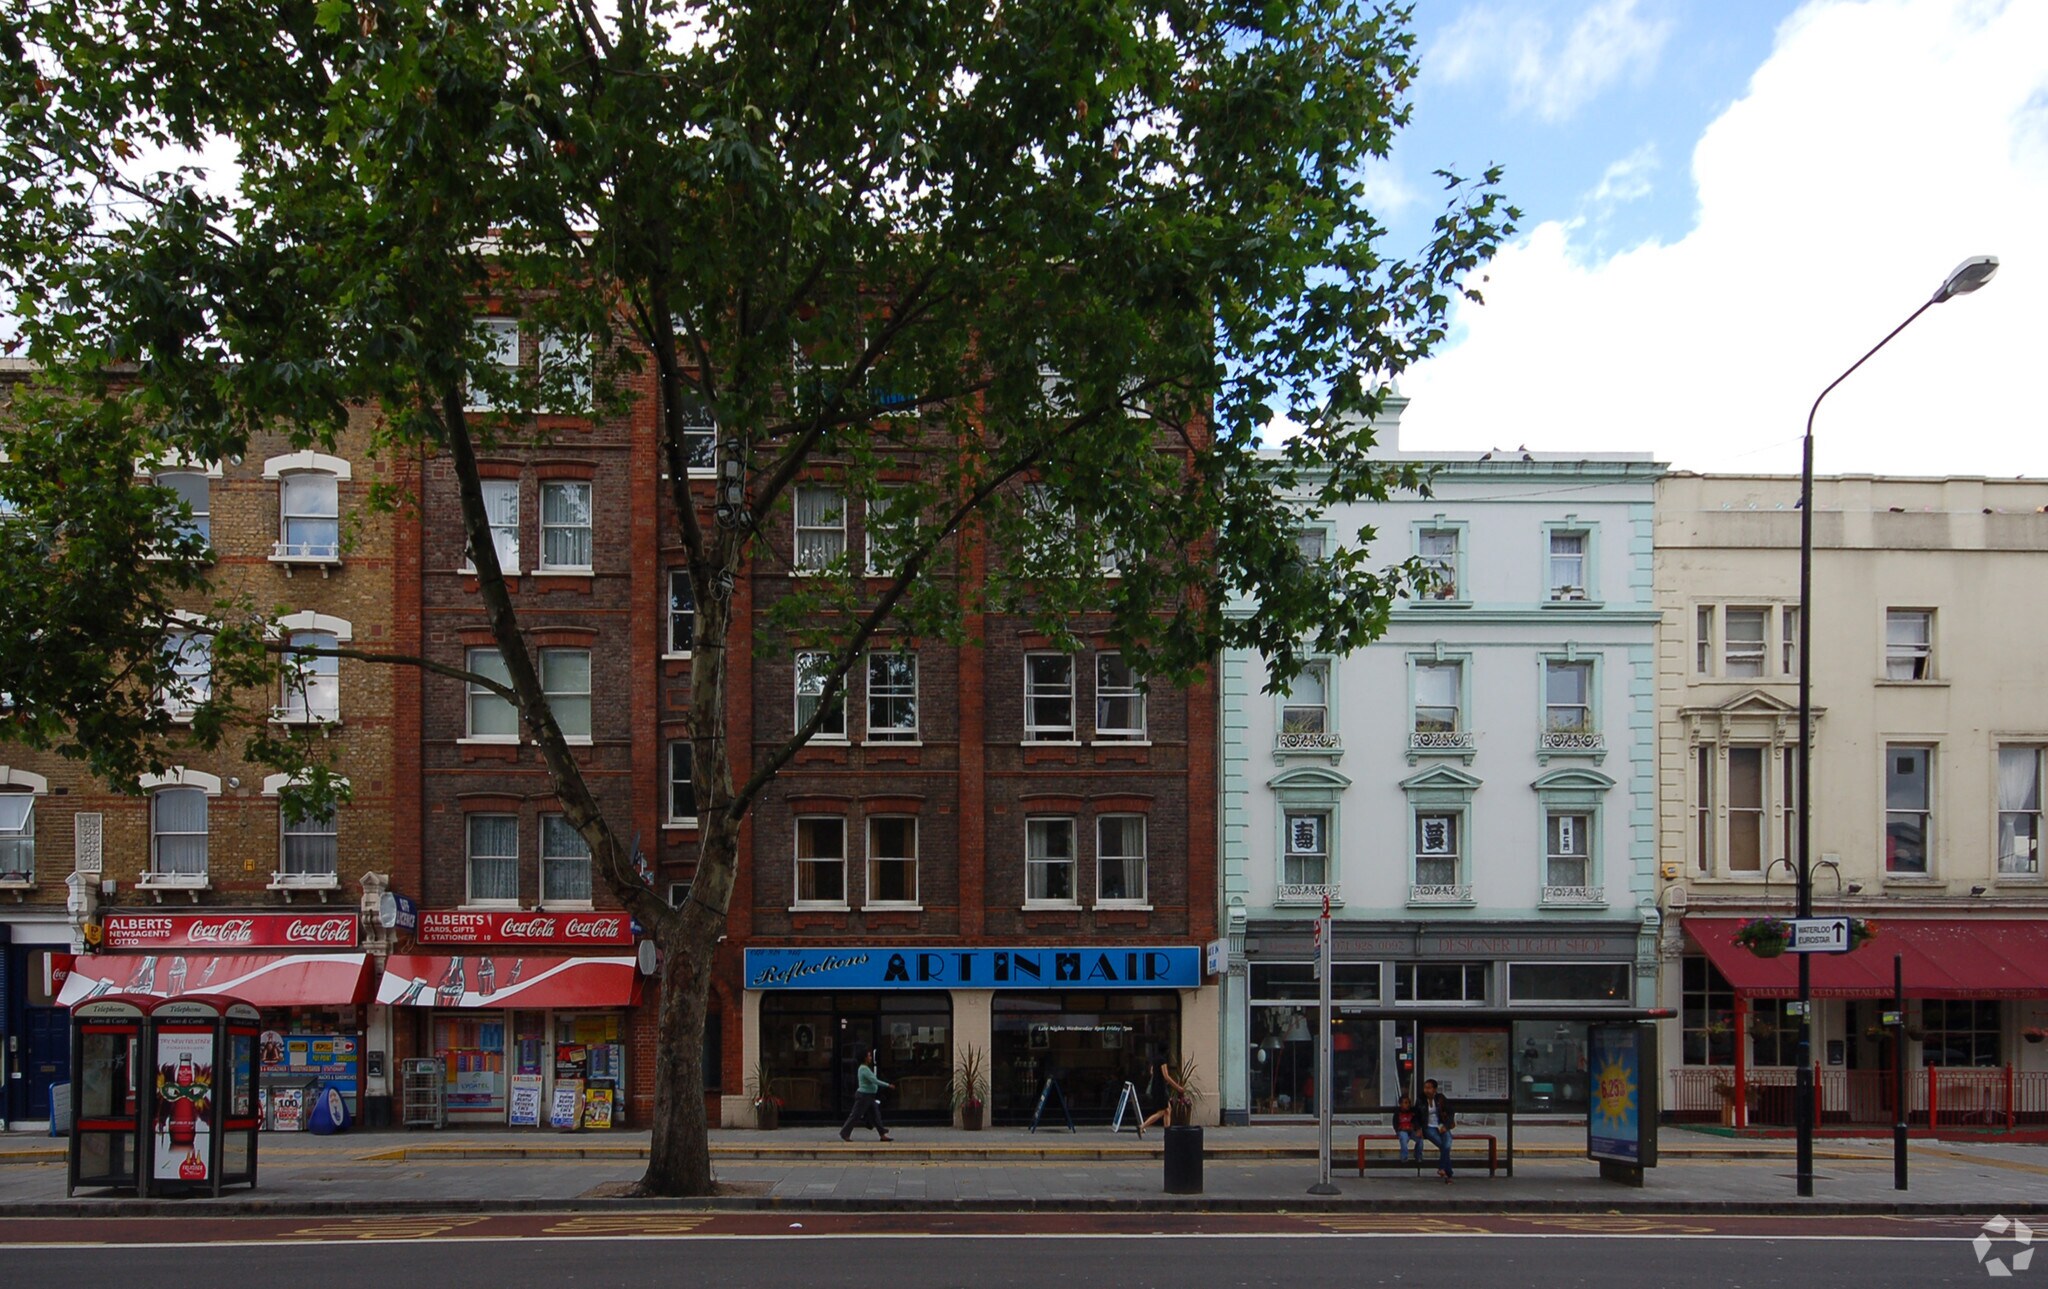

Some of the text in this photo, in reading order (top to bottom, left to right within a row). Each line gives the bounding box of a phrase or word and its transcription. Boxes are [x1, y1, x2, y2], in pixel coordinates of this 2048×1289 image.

[109, 919, 352, 942] ALBERTS Coca-Cola Coca-Cola
[424, 914, 485, 926] ALBERTS
[501, 917, 556, 938] Coca-Cola
[565, 918, 621, 939] Coca-Cola
[1798, 926, 1831, 934] WATERLOO
[109, 930, 171, 938] NEWSAGENTS
[109, 938, 139, 946] LOTTO
[1798, 936, 1831, 944] EUROSTAR
[1438, 937, 1606, 953] DESIGNER LIGHT SHOP
[752, 953, 870, 985] Reflections
[884, 952, 1171, 982] ART IN HAIR
[1746, 988, 1902, 998] FULLY LICCED RESTAURAN
[93, 1005, 126, 1014] Telephone
[170, 1005, 202, 1014] Telephone
[1050, 1024, 1065, 1033] Nights
[1066, 1024, 1093, 1032] Wednesday
[1106, 1024, 1121, 1033] Friday
